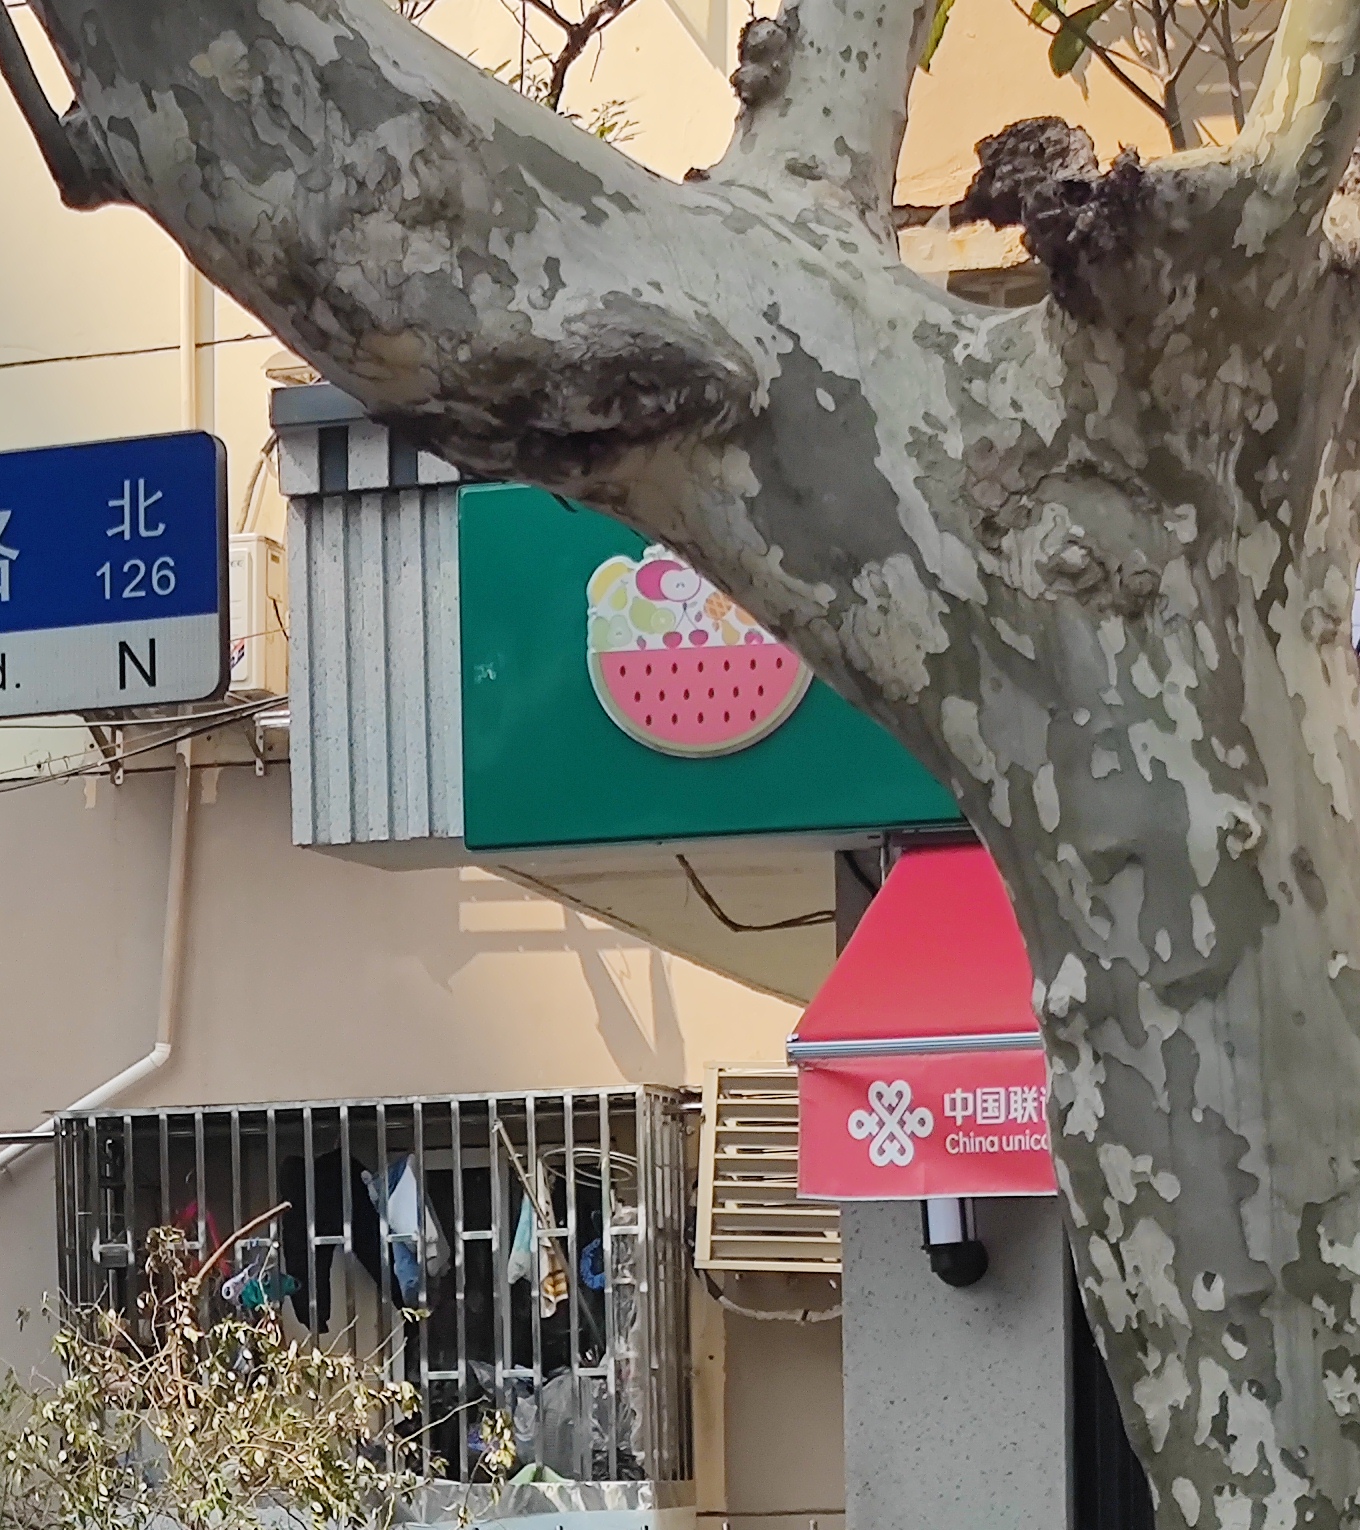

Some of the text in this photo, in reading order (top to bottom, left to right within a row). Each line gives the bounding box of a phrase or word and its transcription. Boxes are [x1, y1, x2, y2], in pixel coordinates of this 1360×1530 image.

[105, 477, 167, 544] 北
[94, 555, 178, 602] 126
[117, 637, 159, 692] N
[945, 1131, 1000, 1155] China
